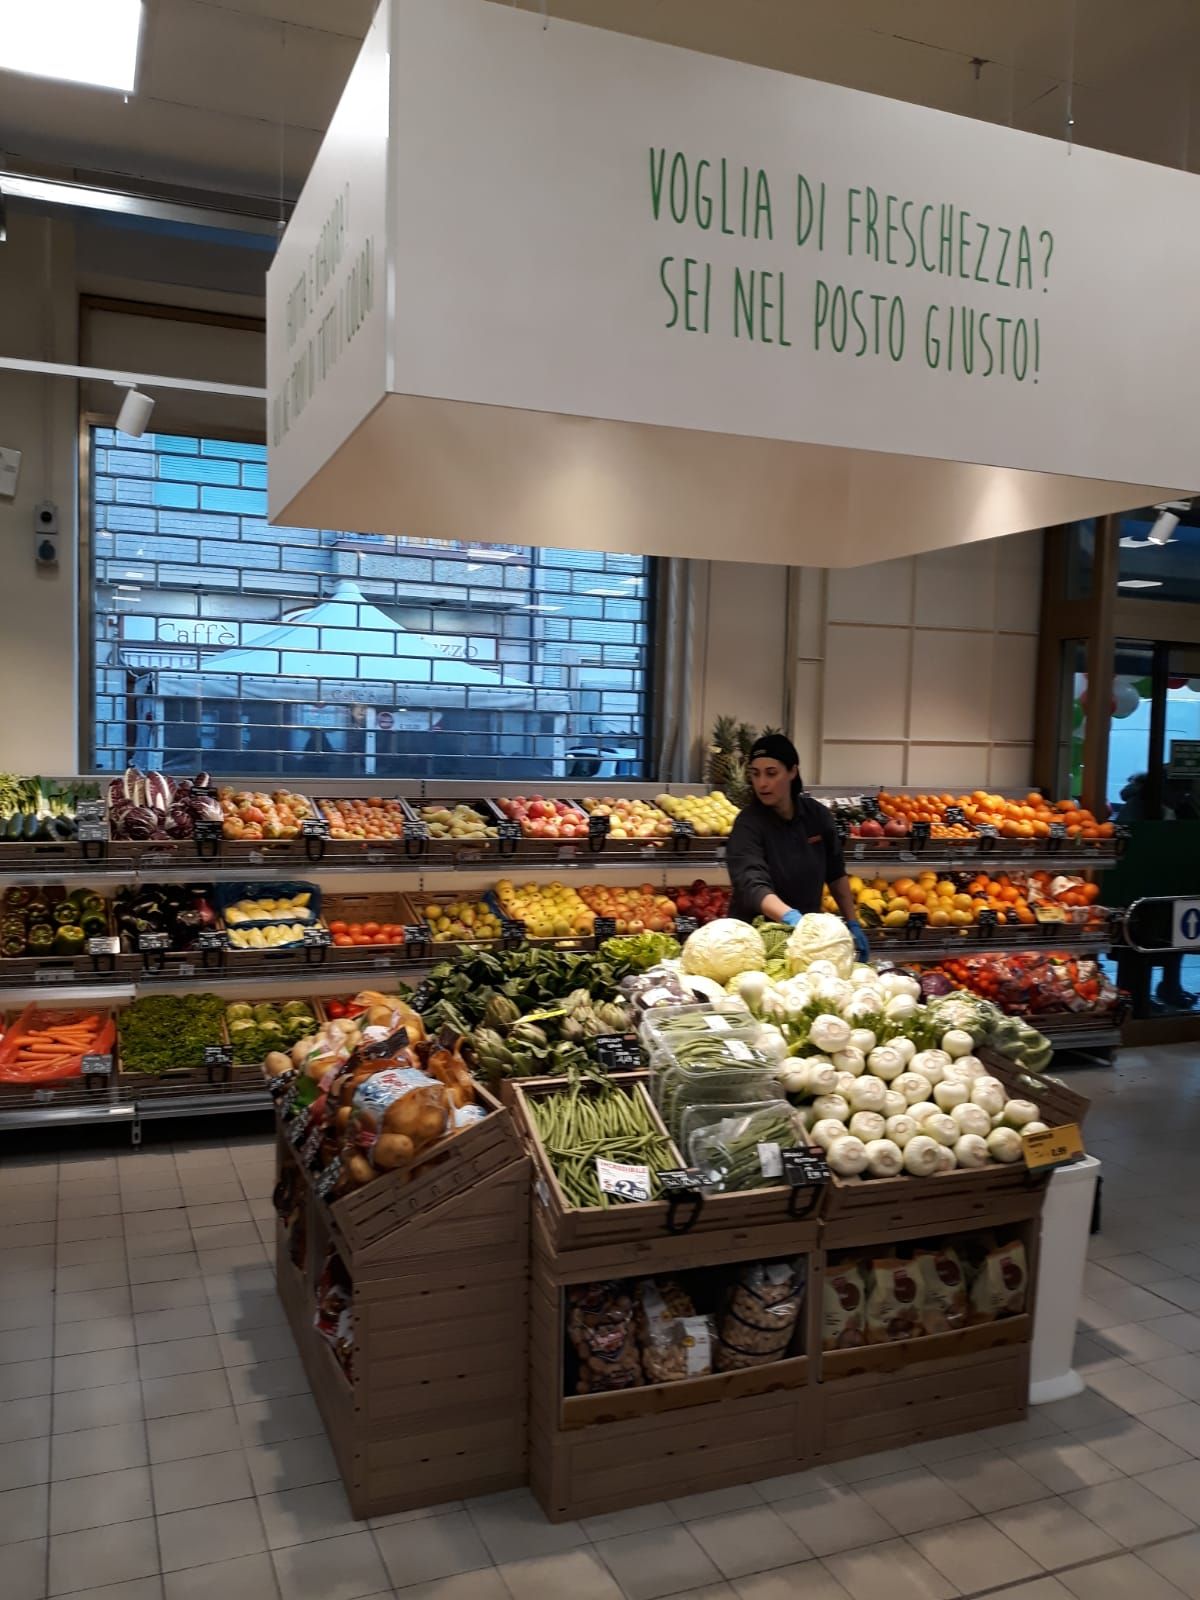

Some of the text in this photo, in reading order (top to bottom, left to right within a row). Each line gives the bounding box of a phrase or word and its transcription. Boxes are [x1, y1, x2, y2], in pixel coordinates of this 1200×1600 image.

[650, 147, 1053, 293] VOGLIA DI FRESCHEZZA?
[660, 257, 1039, 384] SEI NEL POSTO GIUSTO!
[158, 622, 236, 646] Caffè
